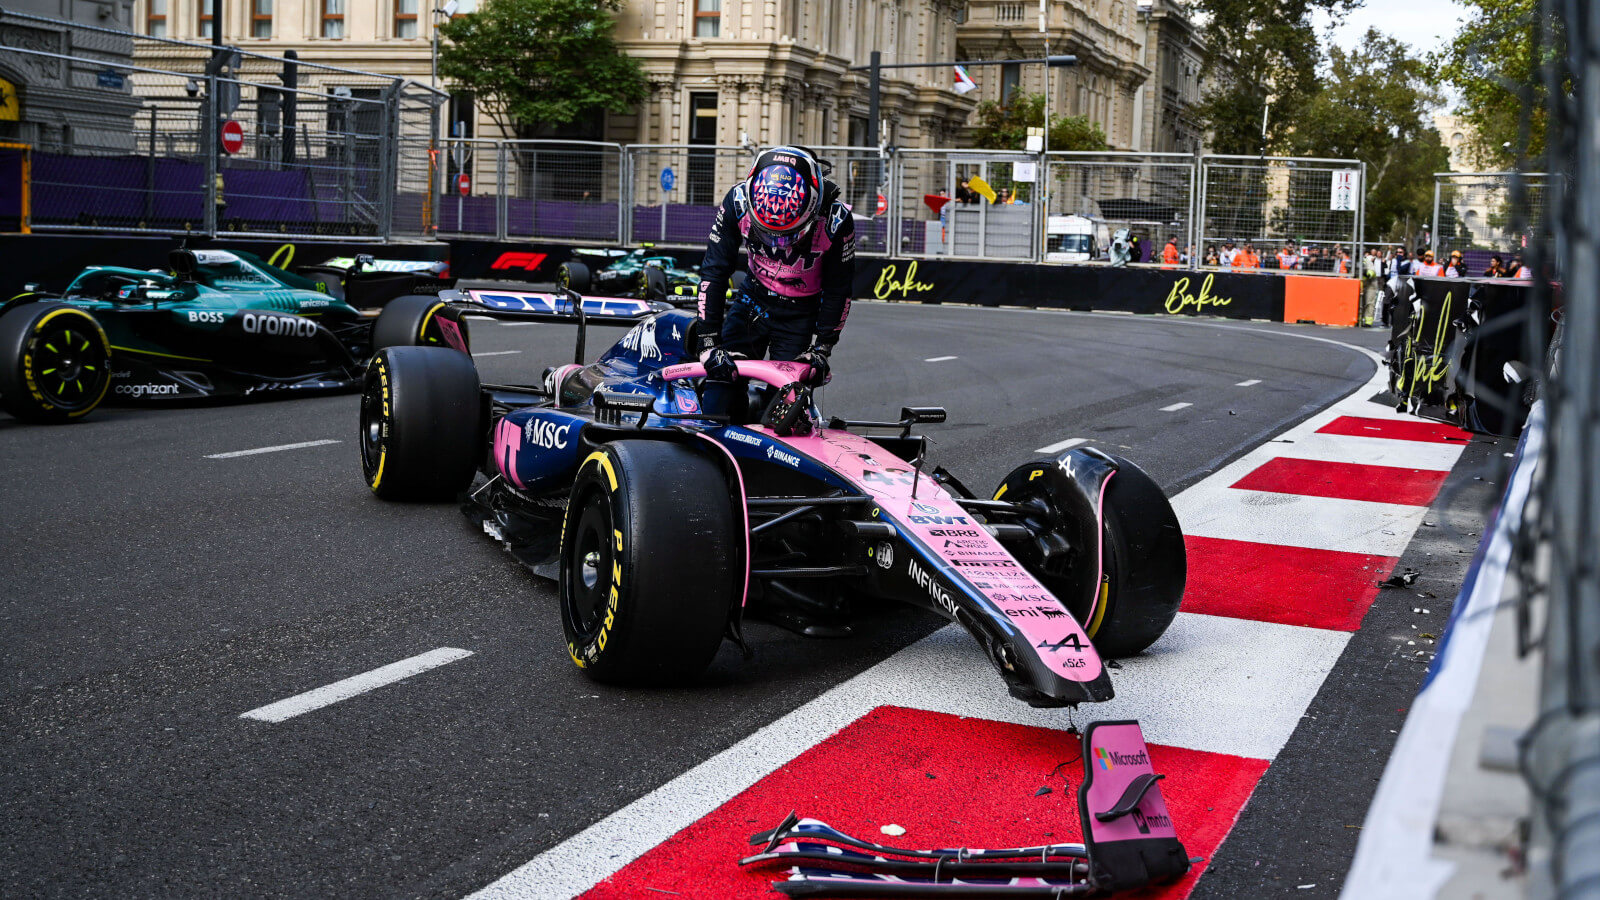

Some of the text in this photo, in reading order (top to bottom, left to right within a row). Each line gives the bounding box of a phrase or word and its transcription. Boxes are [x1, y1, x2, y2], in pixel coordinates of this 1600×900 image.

[491, 252, 547, 271] F1
[316, 282, 326, 294] 18
[874, 261, 934, 300] Baku
[1165, 273, 1231, 314] Baku
[189, 311, 224, 323] BOSS
[243, 314, 317, 337] aramco
[115, 382, 179, 397] cognizant
[532, 418, 571, 449] MSC
[774, 449, 800, 467] BINANCE
[907, 515, 970, 525] BWT
[908, 559, 960, 622] INFINOX
[1010, 594, 1056, 602] MSC
[598, 559, 622, 651] ZERO
[1005, 606, 1039, 617] eni
[1109, 750, 1149, 766] Microsoft
